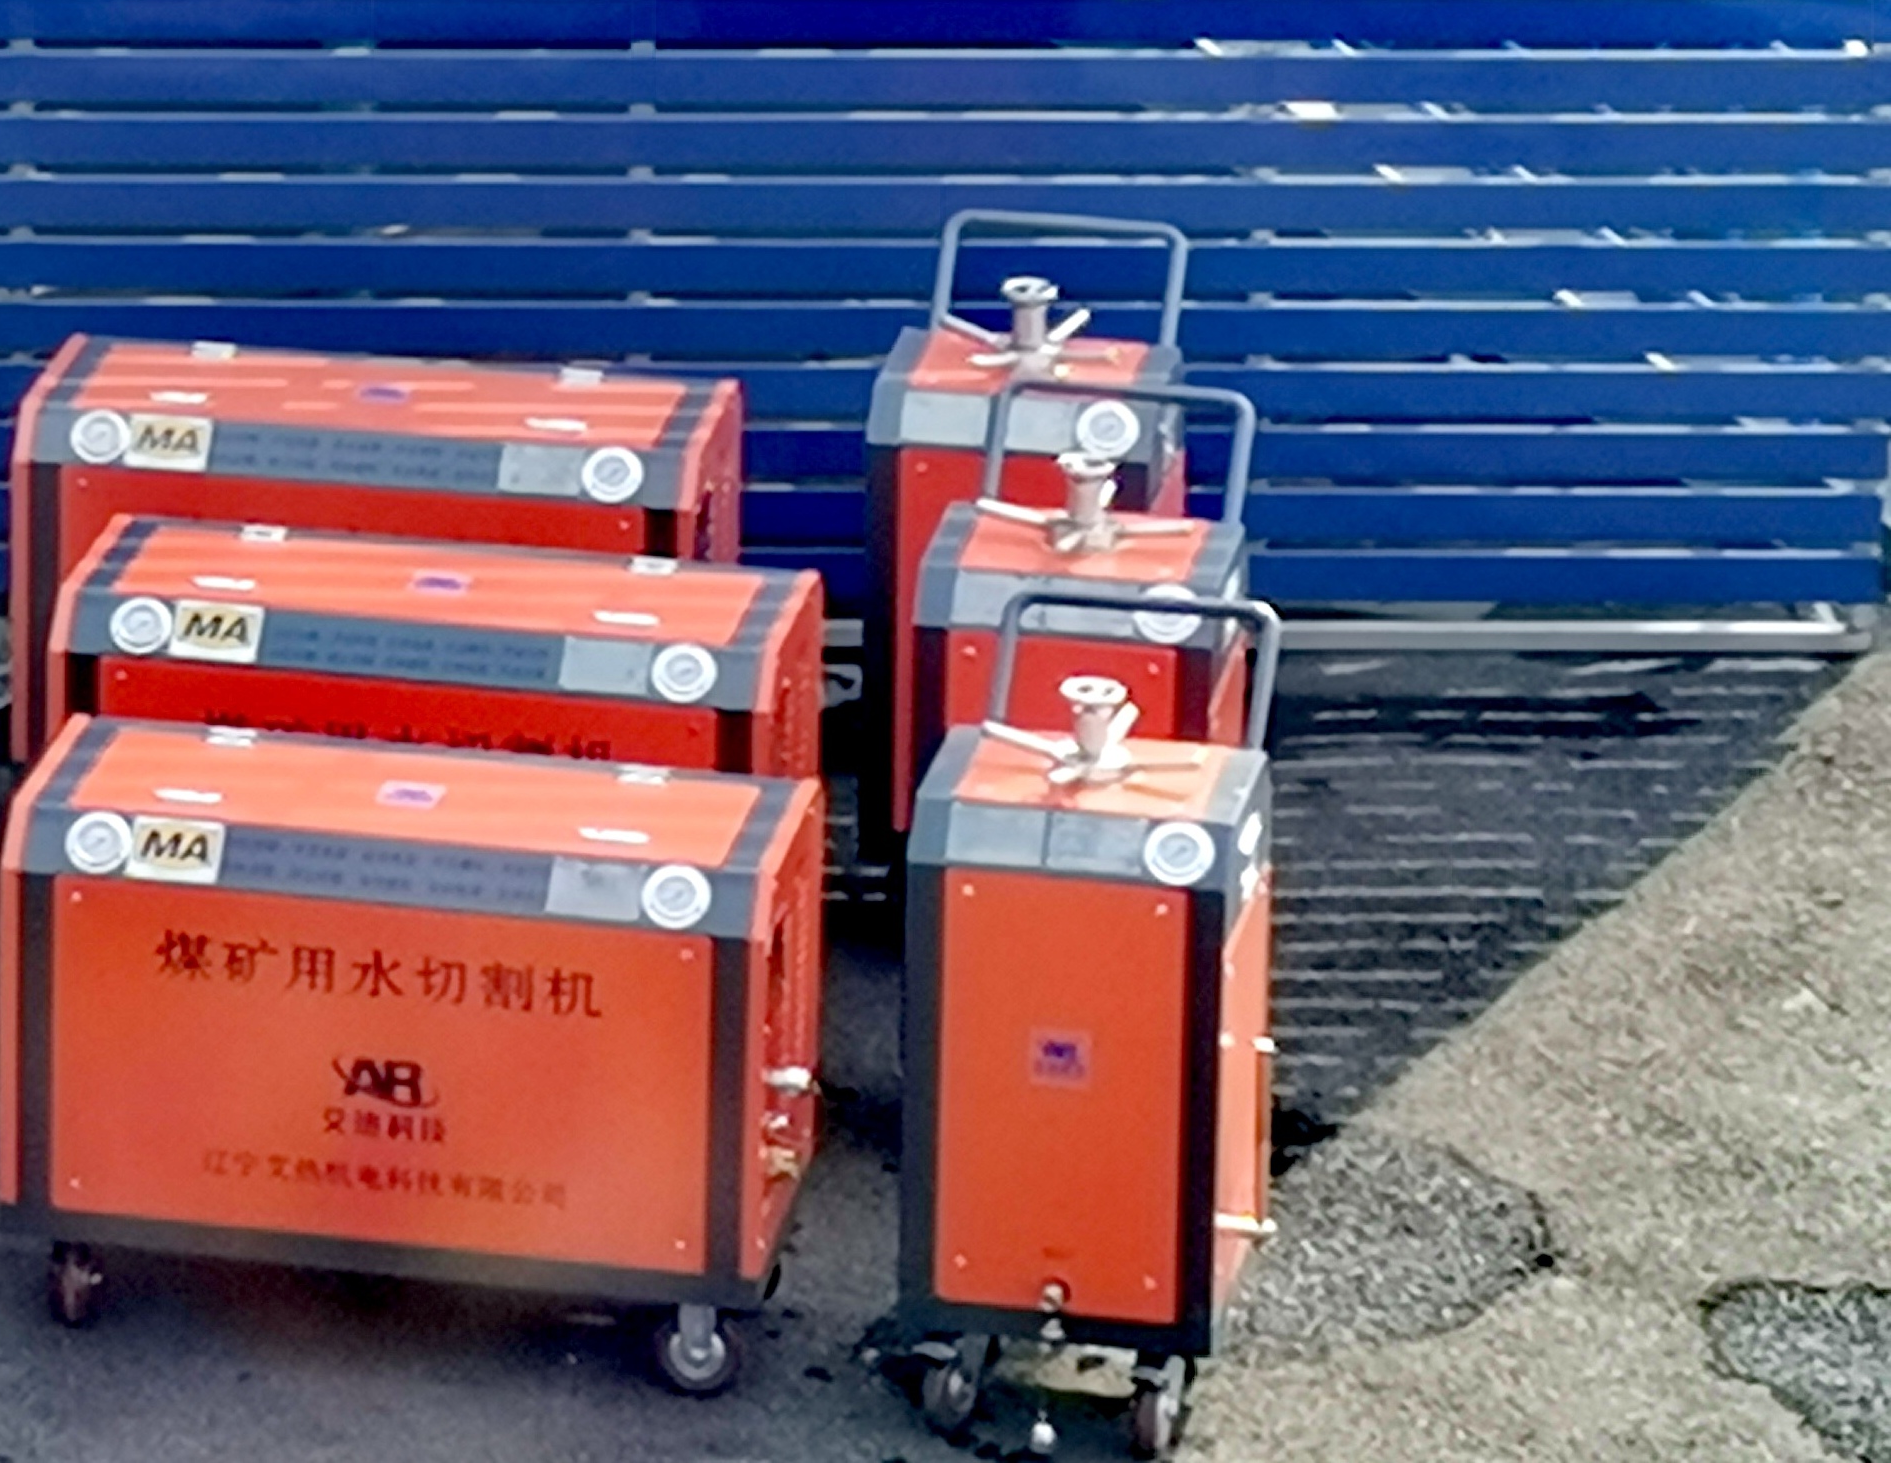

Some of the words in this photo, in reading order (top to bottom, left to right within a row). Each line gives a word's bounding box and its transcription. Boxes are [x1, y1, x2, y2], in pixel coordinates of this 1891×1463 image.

[134, 423, 203, 457] MA
[181, 610, 251, 646] MA
[139, 828, 212, 865] MA
[156, 928, 604, 1019] 煤矿用水切割机
